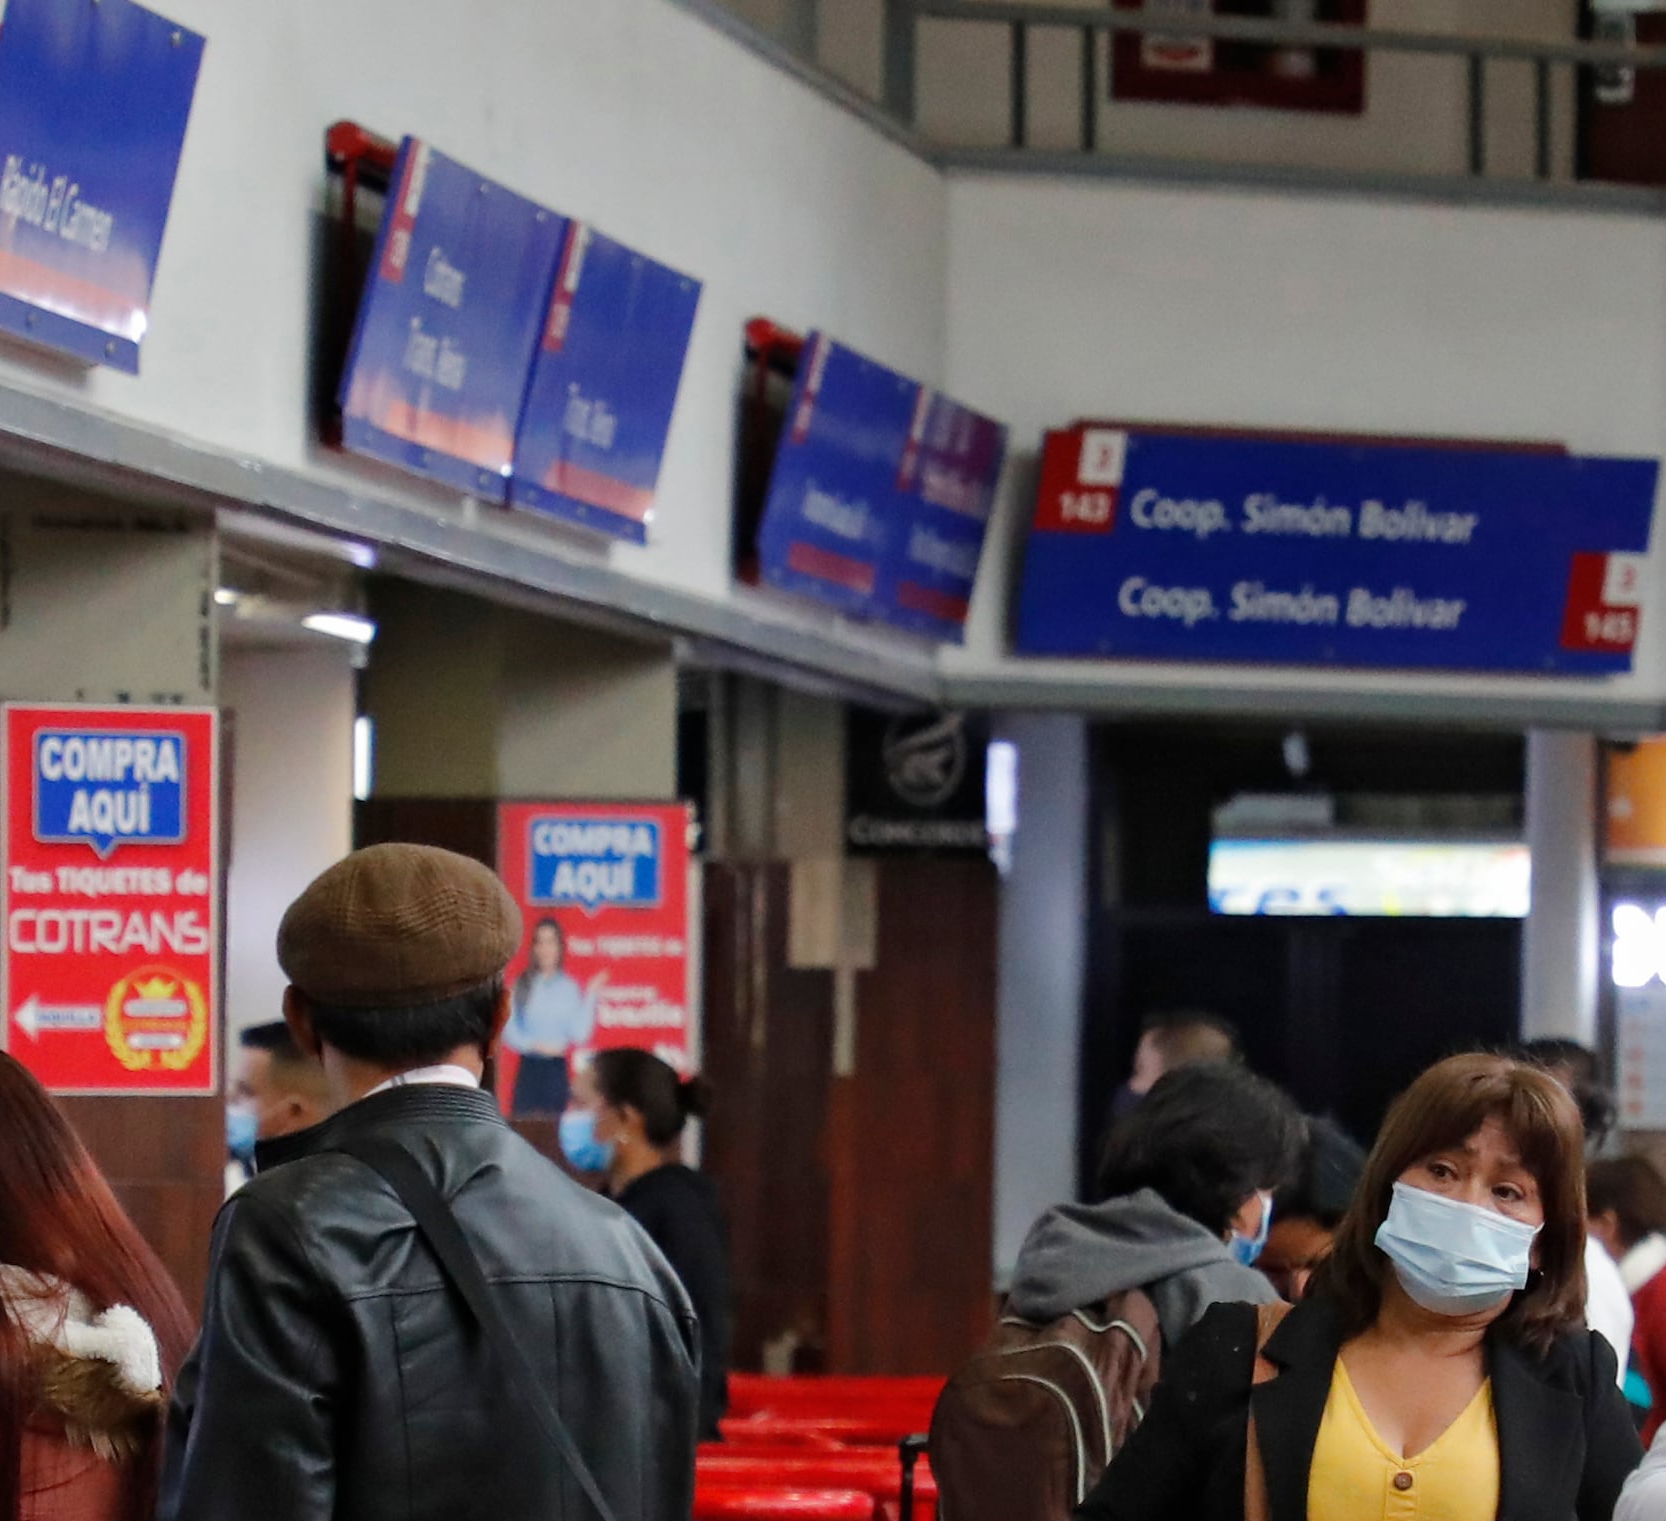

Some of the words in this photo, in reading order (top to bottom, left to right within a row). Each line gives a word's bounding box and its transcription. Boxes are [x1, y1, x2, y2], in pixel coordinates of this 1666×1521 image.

[1131, 489, 1231, 541] Coop.
[1241, 493, 1352, 537] Simón
[1118, 577, 1221, 627] Coop.
[1228, 580, 1339, 625] Simón
[40, 737, 180, 783] COMPRA
[67, 781, 152, 835] AQUÍ
[534, 823, 653, 858] COMPRA
[10, 866, 53, 894] Tus
[58, 866, 171, 898] TIQUETES
[176, 869, 209, 896] de
[551, 854, 636, 900] AQUÍ
[9, 908, 210, 955] COTRANS
